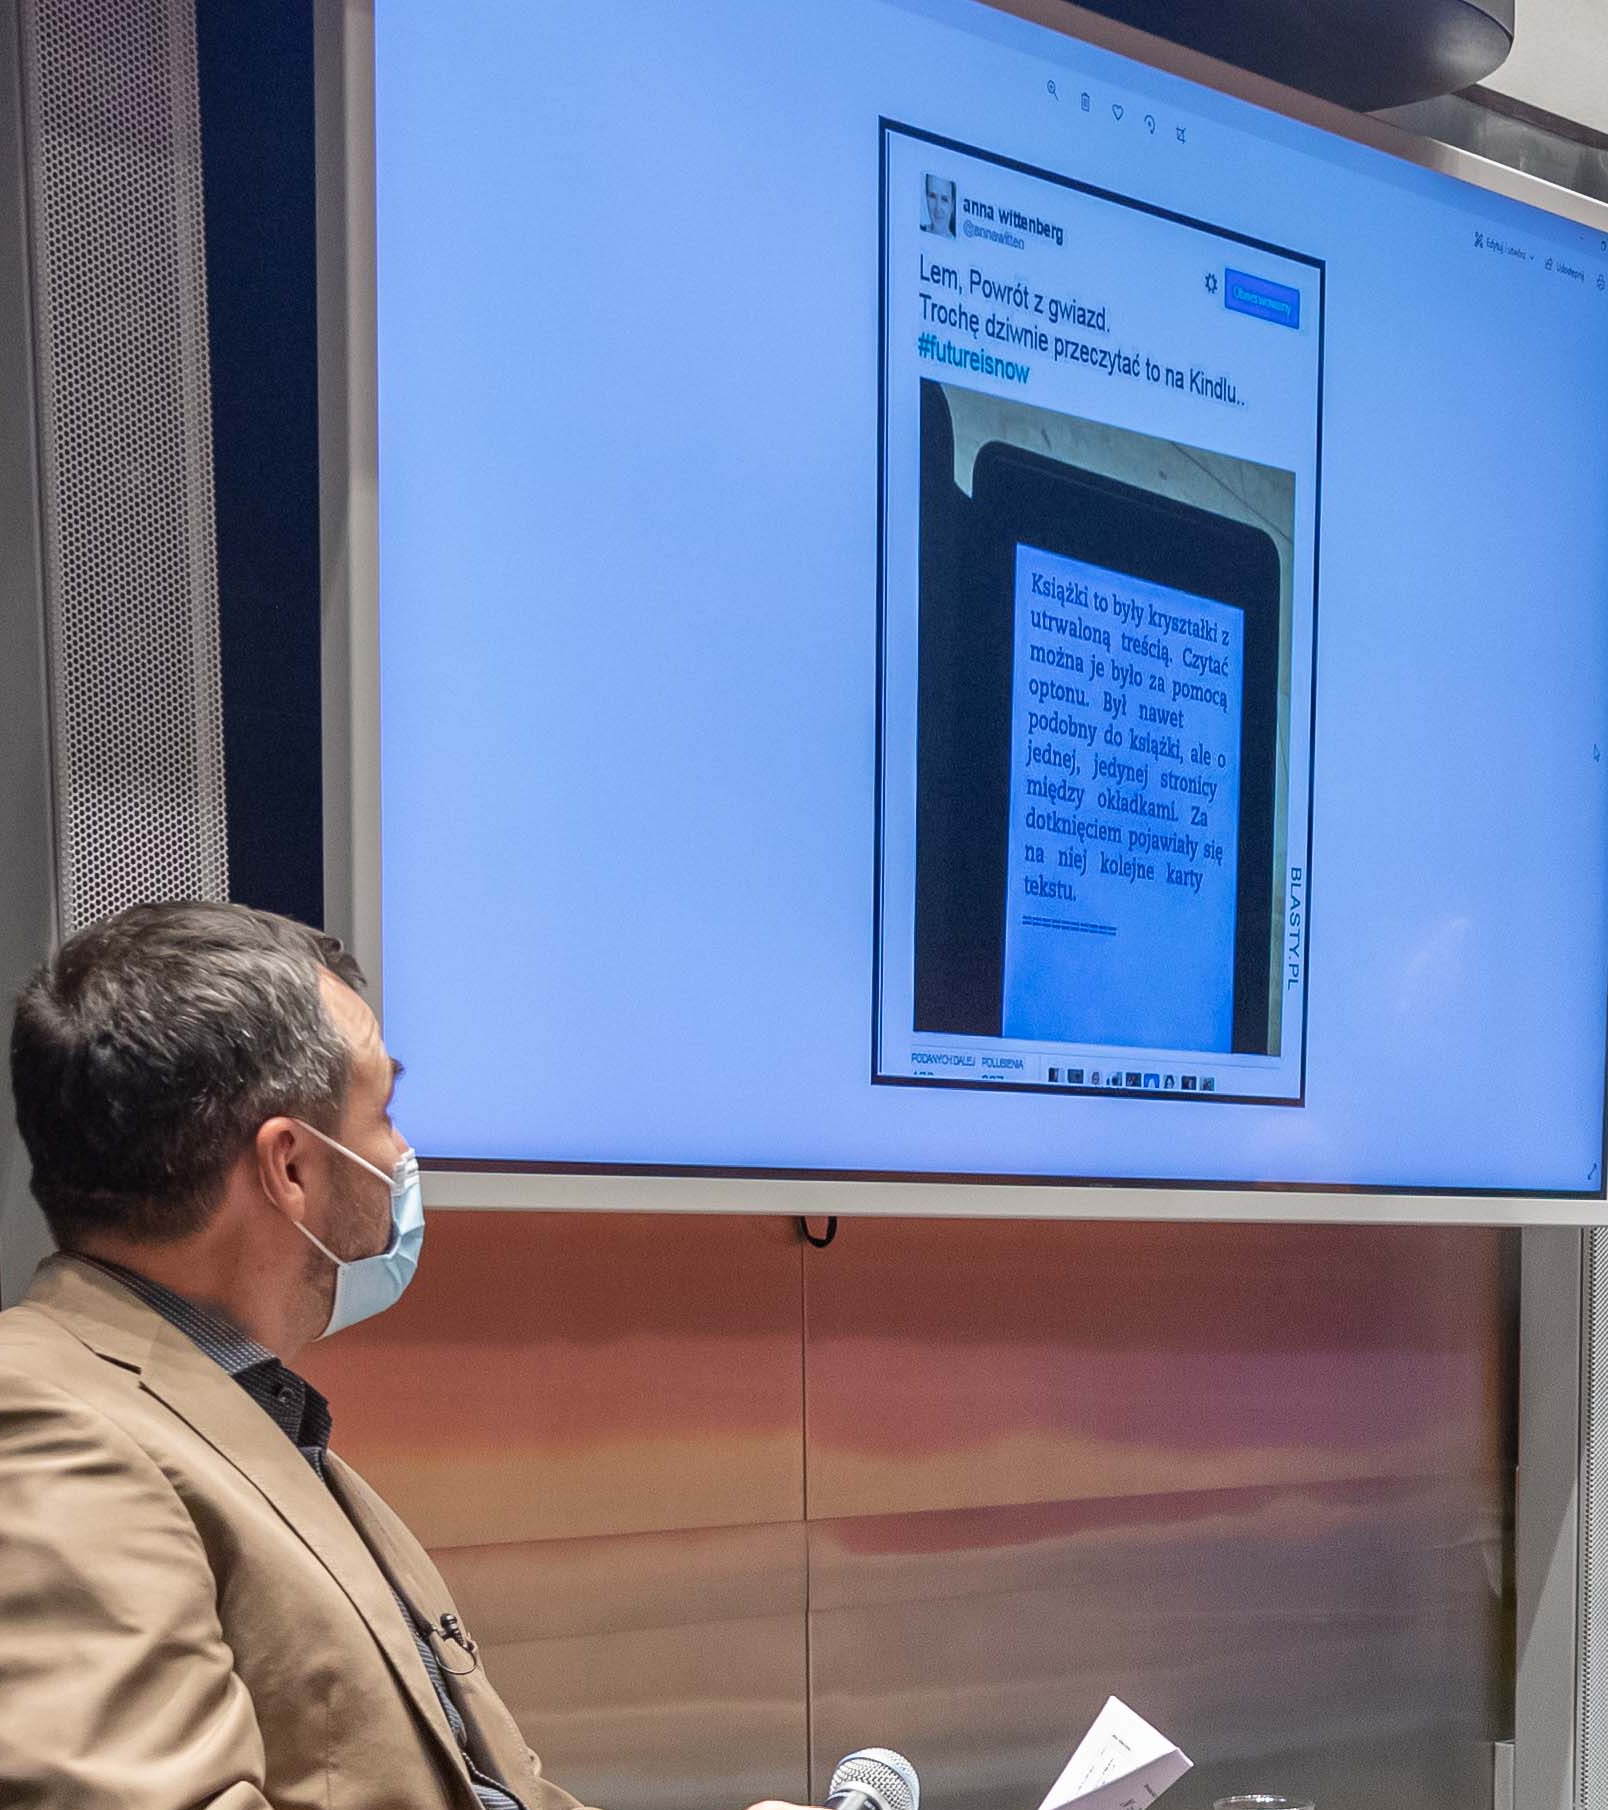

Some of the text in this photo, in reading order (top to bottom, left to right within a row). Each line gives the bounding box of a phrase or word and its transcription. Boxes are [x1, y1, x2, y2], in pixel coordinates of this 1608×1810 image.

[963, 198, 1064, 246] anna wittenberg
[919, 254, 1110, 333] Lem, Powrót z gwiazd.
[917, 331, 1030, 384] #futureisnow
[919, 293, 1246, 406] Trochę dziwnie przeczytać to na Kindlu..
[1031, 572, 1230, 646] Książki to były kryształki z
[1030, 609, 1229, 677] utrwaloną treścią. Czytać
[1029, 643, 1084, 674] można
[1089, 655, 1105, 682] je
[1149, 673, 1165, 693] za
[1172, 679, 1228, 713] pomocą
[1029, 677, 1185, 730] optonu. Był nawet
[1028, 711, 1227, 768] podobny do książki, ale o
[1025, 739, 1218, 804] jednej, jedynej stronicy
[1025, 777, 1209, 827] między okładkami. Za
[1025, 807, 1224, 866] dotknięciem pojawiały się
[1024, 843, 1204, 894] na niej kolejne karty
[1024, 874, 1077, 902] tekstu.
[1287, 867, 1302, 990] BLASTY.PL
